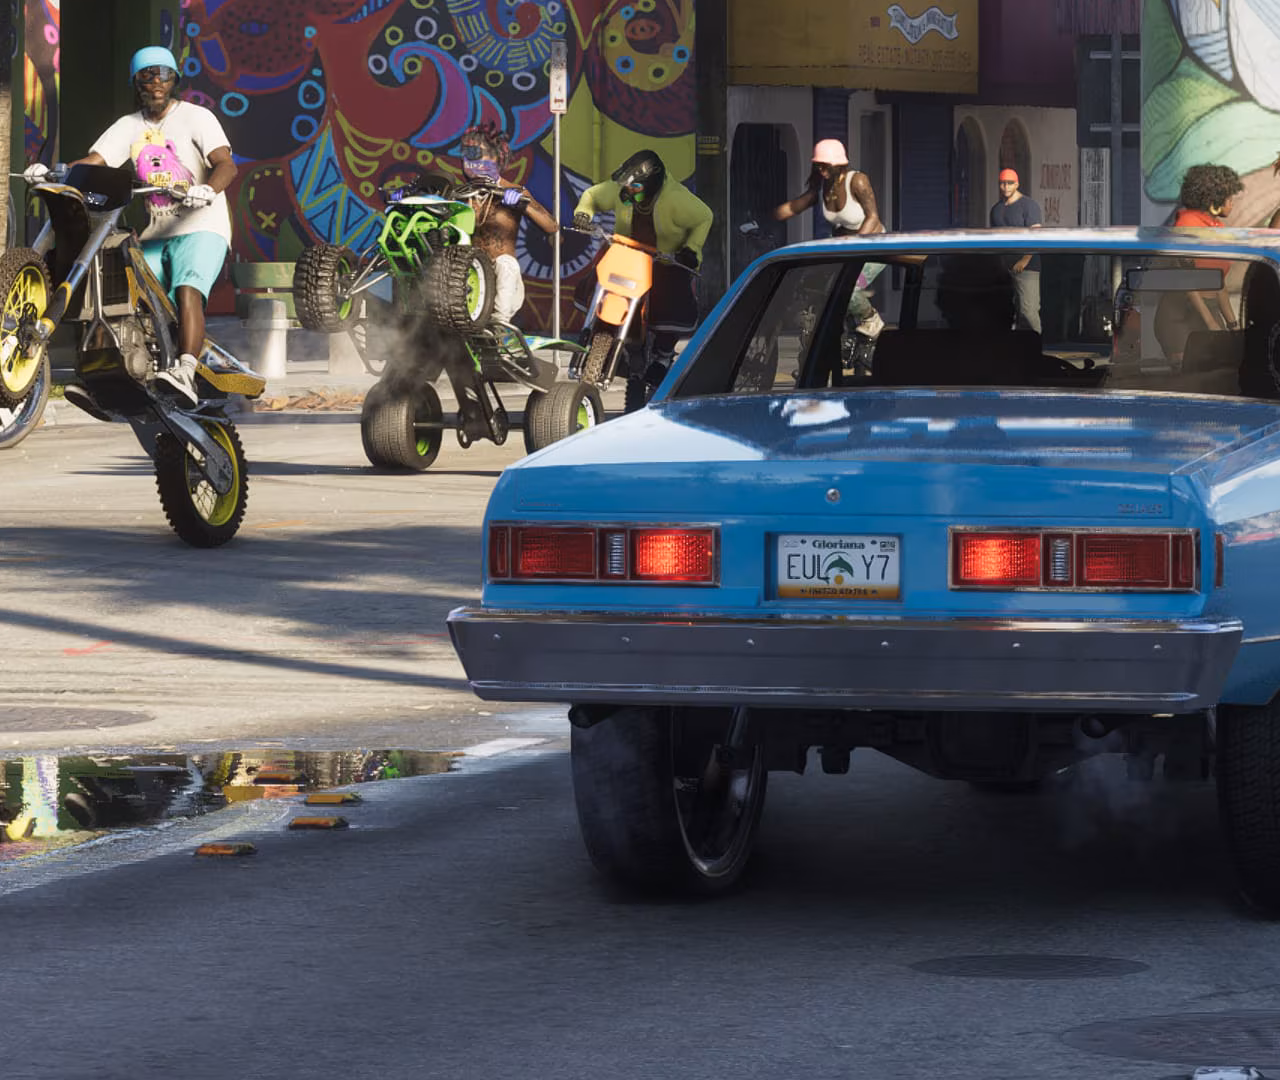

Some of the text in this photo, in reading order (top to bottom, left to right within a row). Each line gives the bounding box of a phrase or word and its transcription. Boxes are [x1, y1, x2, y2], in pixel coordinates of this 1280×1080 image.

[811, 538, 866, 550] Gloriana
[787, 554, 890, 580] EUL Y7
